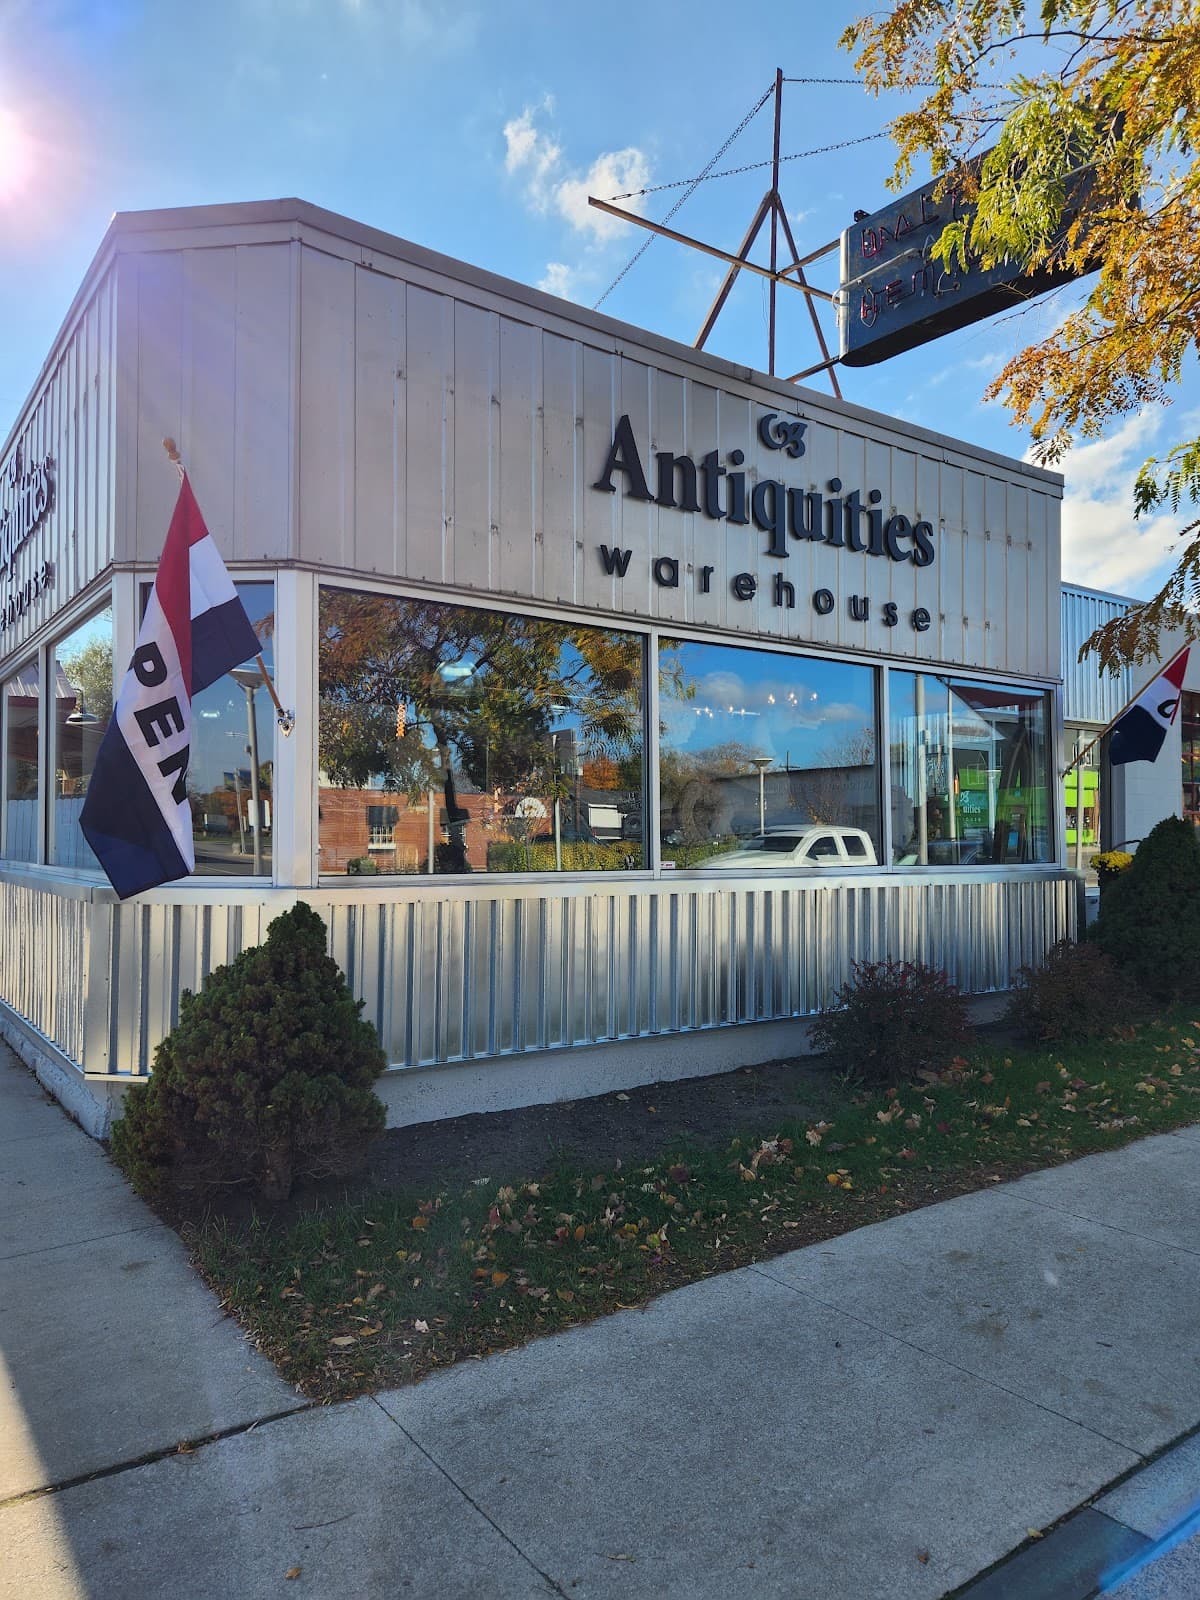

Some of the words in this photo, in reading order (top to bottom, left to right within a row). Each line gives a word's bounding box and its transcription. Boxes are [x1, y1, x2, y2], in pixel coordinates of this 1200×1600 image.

[593, 414, 936, 567] Antiquities
[600, 544, 932, 632] warehouse
[133, 641, 190, 805] PEN
